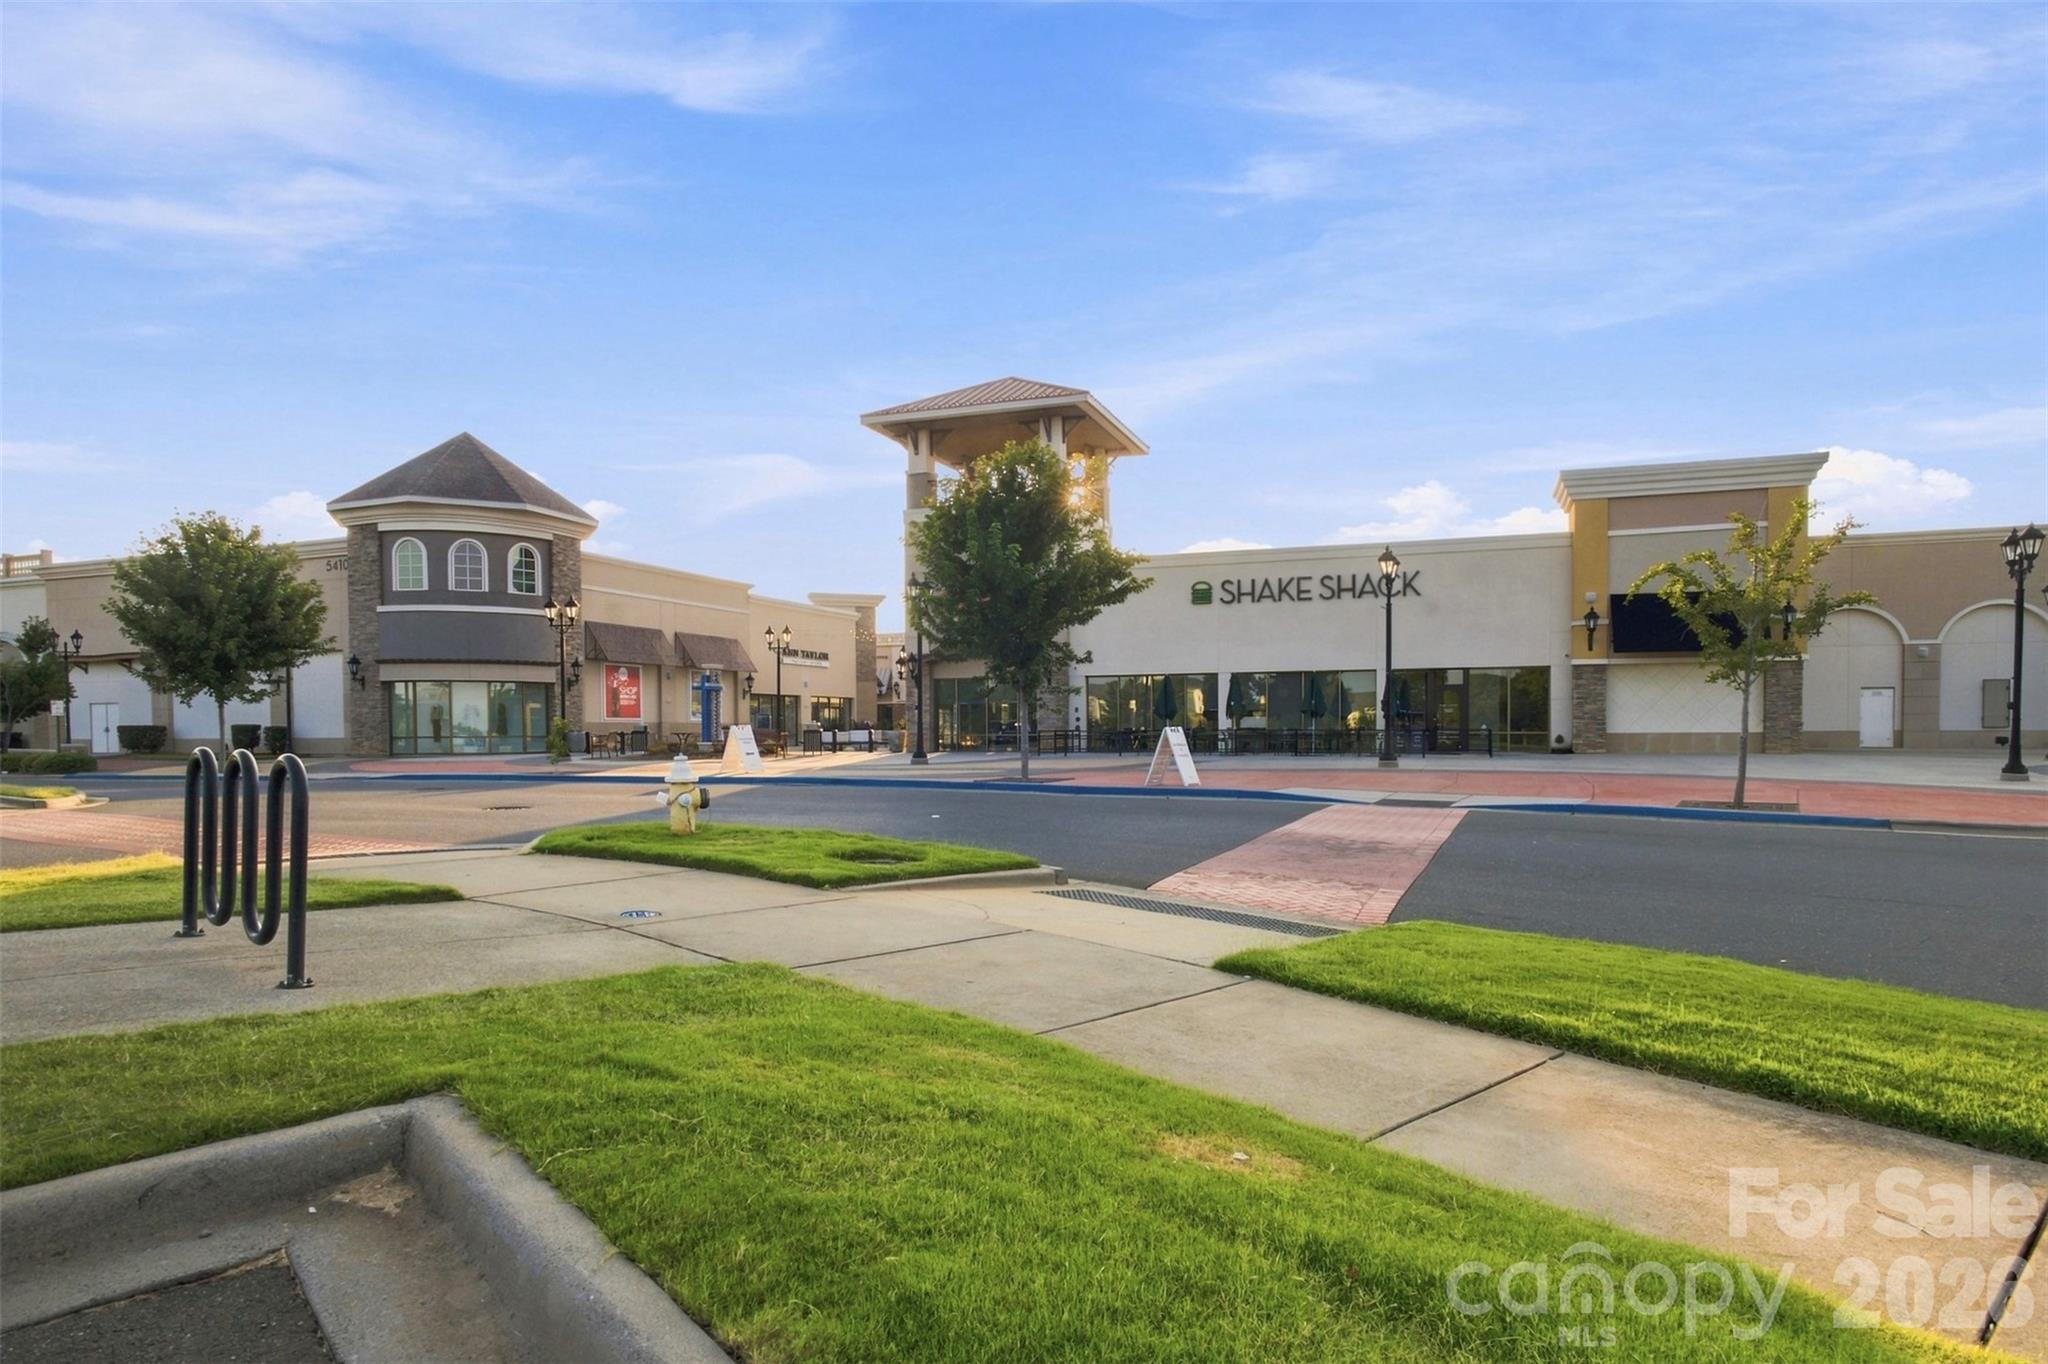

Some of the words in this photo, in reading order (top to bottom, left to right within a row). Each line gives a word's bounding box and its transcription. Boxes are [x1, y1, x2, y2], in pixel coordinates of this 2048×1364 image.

[325, 559, 349, 572] 5410
[1219, 576, 1313, 605] SHAKE
[1318, 570, 1422, 600] SHACK
[800, 649, 829, 661] TAYLOR
